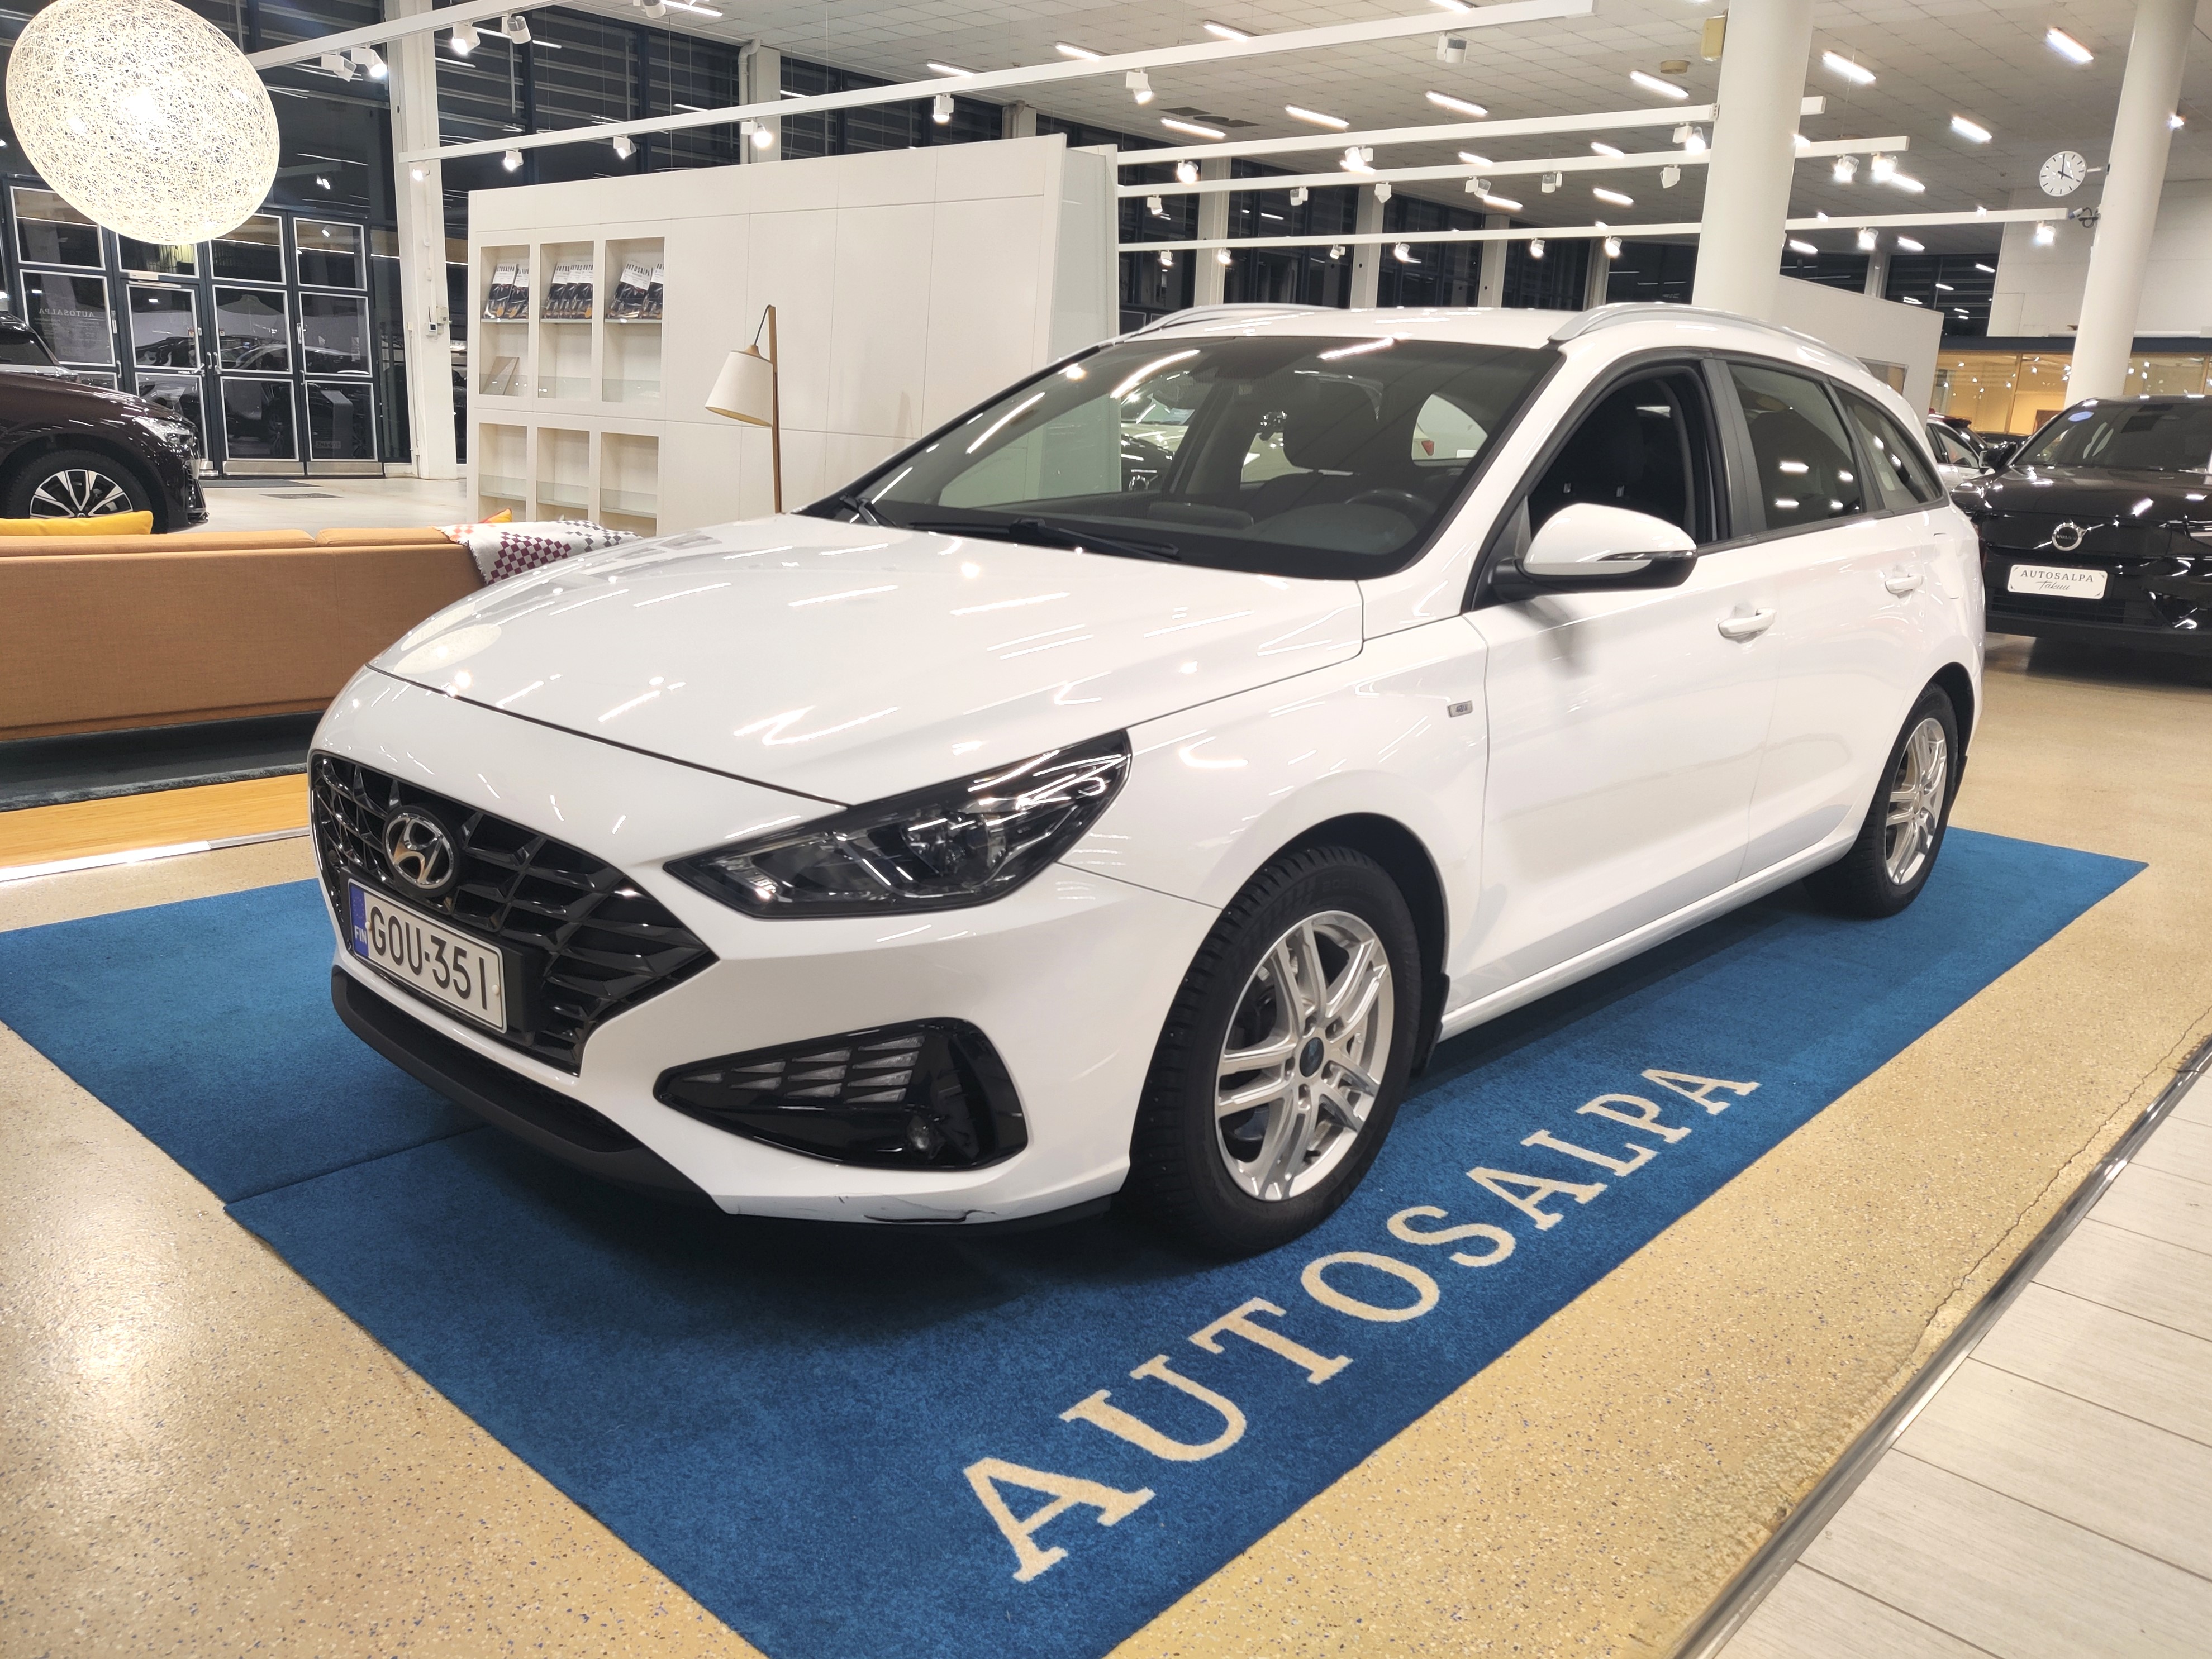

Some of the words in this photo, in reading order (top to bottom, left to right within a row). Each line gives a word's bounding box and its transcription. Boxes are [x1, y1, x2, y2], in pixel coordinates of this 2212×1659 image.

[626, 263, 650, 276] AUTOSALPA
[2020, 570, 2094, 583] AUTOSALPA
[2036, 580, 2070, 590] Takuu
[354, 925, 367, 945] FIN
[370, 906, 487, 1011] GOU-351
[963, 1068, 1761, 1584] AUTOSALPA
